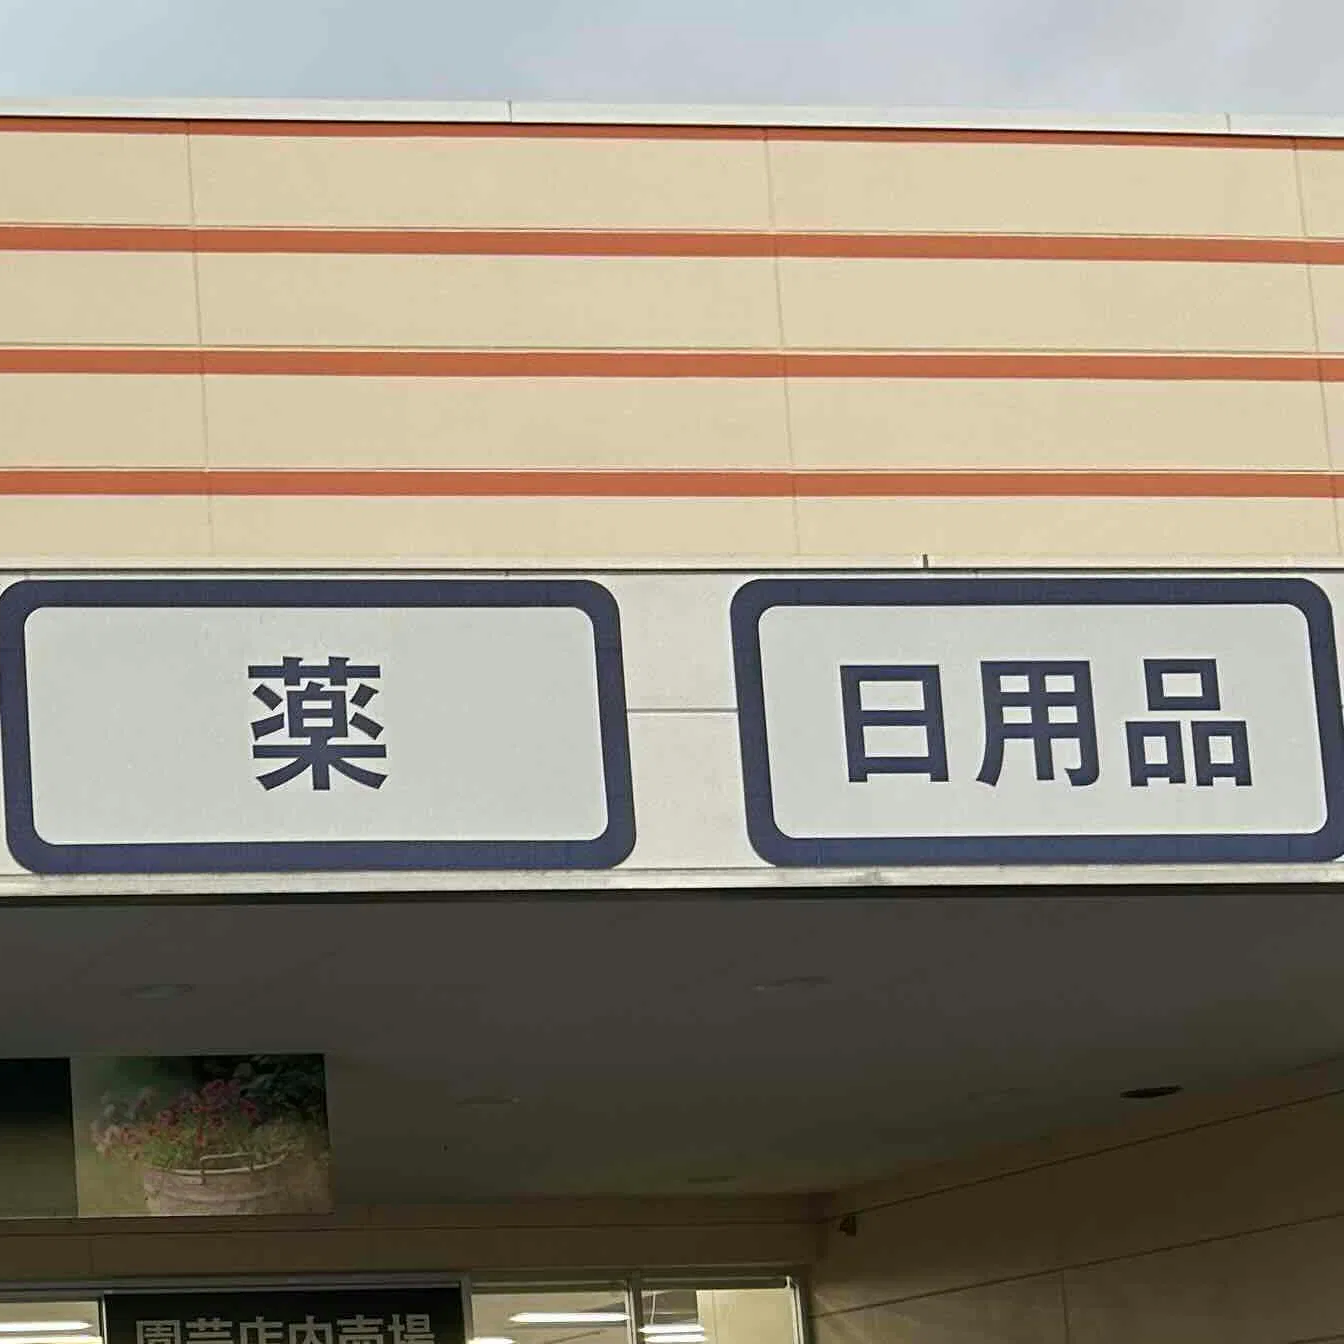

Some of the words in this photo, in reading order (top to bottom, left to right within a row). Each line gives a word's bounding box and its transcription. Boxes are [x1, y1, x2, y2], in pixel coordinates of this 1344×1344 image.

[247, 656, 388, 791] 薬
[839, 658, 1252, 787] 日用品
